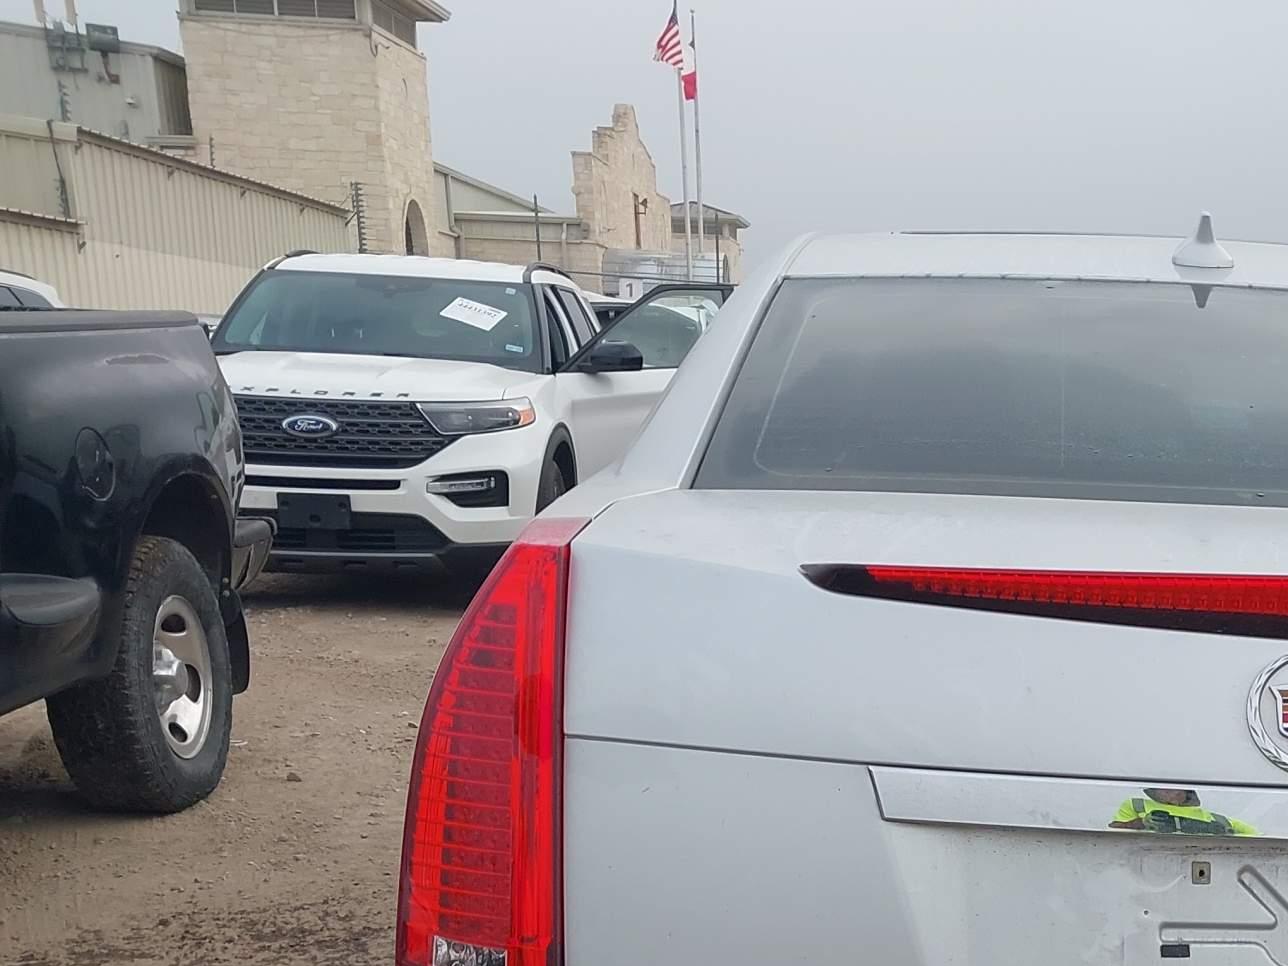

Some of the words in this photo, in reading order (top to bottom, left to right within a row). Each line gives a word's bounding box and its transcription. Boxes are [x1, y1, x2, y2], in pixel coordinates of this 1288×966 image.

[625, 282, 633, 298] 1
[229, 385, 411, 398] XPLORER
[294, 419, 324, 432] Ford
